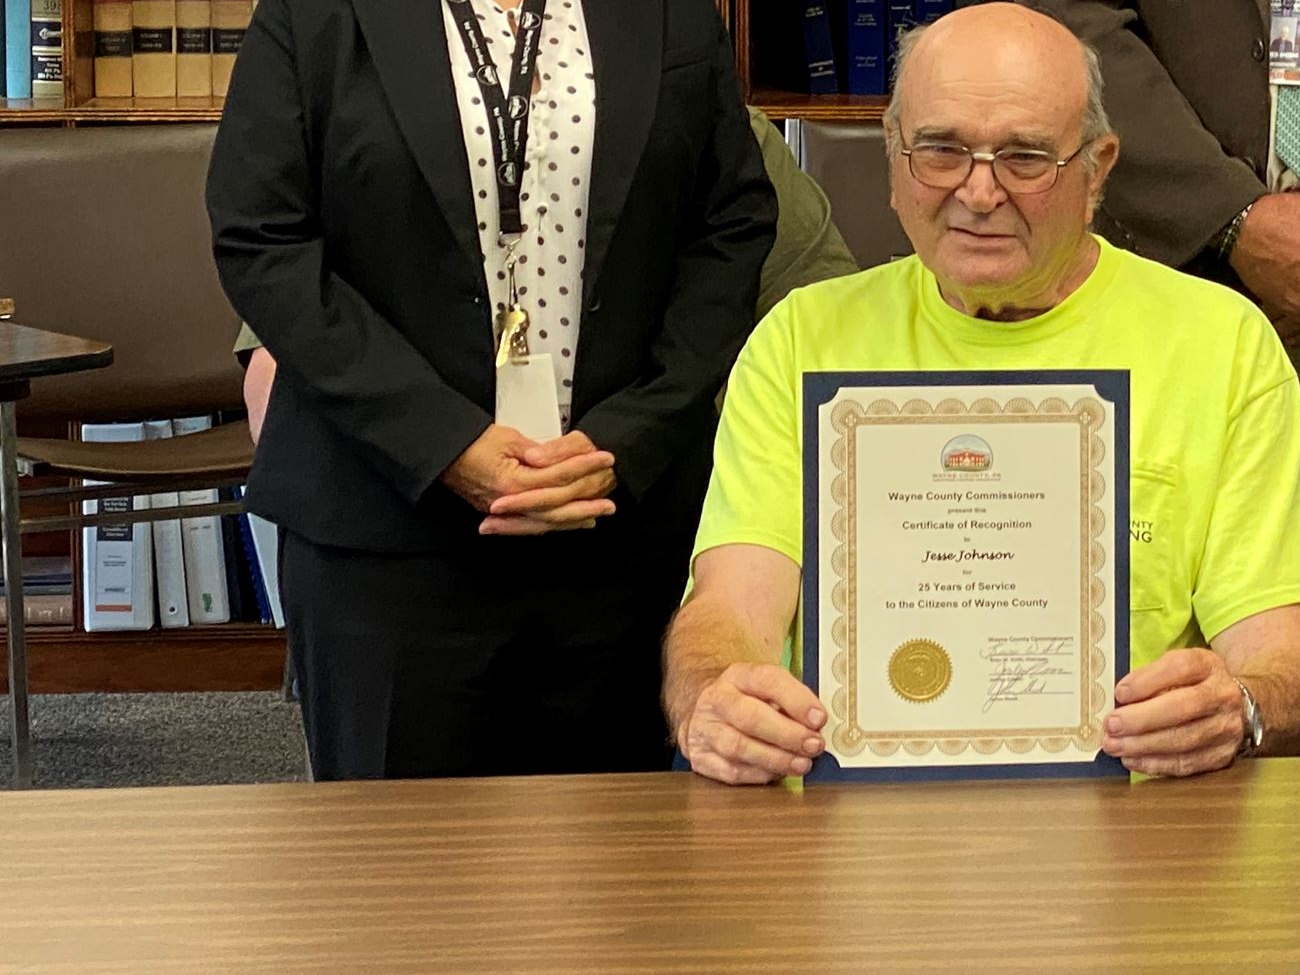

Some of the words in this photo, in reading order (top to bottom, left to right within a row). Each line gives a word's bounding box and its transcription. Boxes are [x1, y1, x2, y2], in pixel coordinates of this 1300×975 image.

[888, 492, 923, 502] Wayne
[926, 491, 962, 502] County
[965, 491, 1045, 500] Commissioners
[902, 521, 954, 530] Certificate
[957, 520, 968, 529] of
[970, 520, 1032, 531] Recognition
[921, 550, 956, 563] Jesse
[955, 549, 1015, 563] Johnson
[918, 583, 930, 592] 25
[933, 582, 962, 591] Years
[965, 582, 975, 591] of
[978, 582, 1016, 591] Service
[898, 600, 915, 608] the
[918, 599, 958, 608] Citizens
[962, 599, 972, 608] of
[974, 599, 1009, 609] Wayne
[1012, 598, 1048, 609] County
